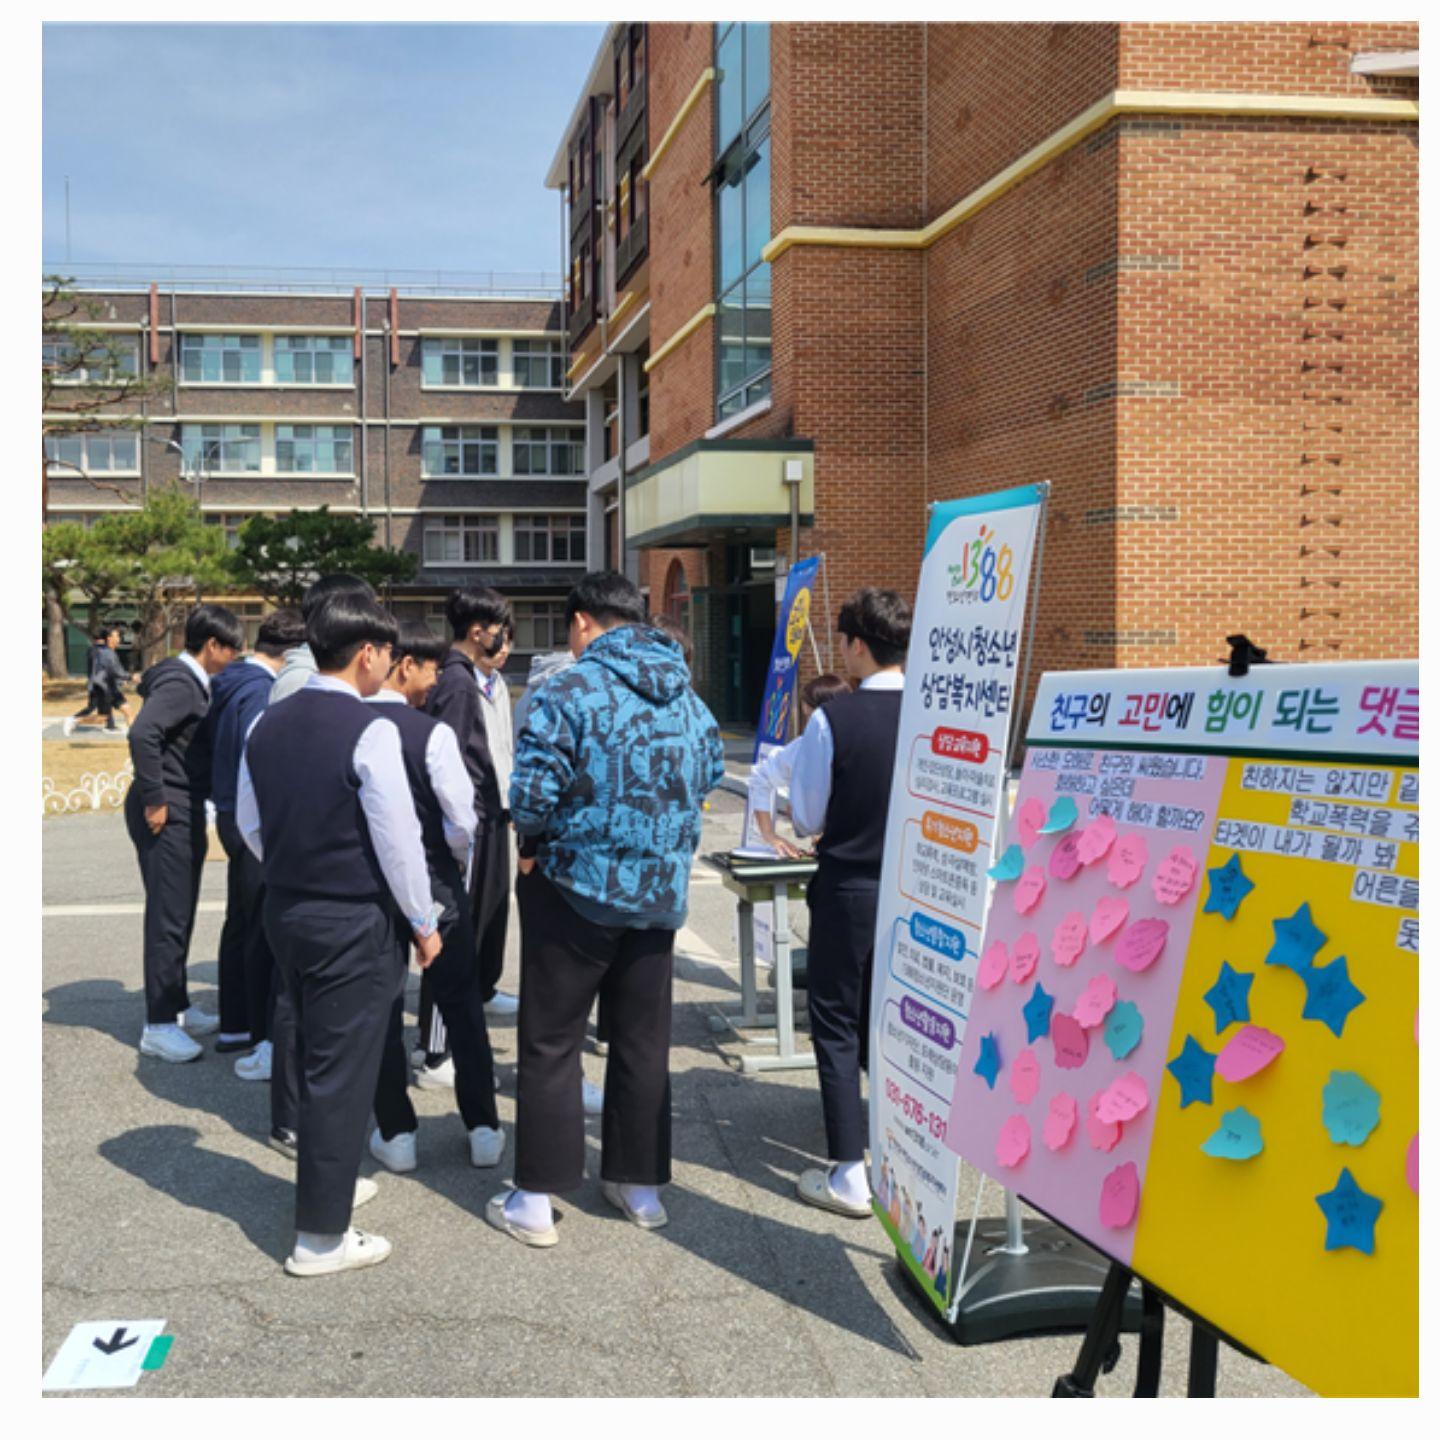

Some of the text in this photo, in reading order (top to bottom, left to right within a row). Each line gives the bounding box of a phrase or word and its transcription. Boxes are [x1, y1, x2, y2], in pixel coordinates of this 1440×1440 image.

[963, 538, 1014, 603] 1388
[929, 626, 1017, 668] 안성시청소년
[920, 672, 1010, 717] 상담복지센터
[1050, 691, 1111, 734] 친구의
[1117, 691, 1196, 733] 고민에
[1204, 688, 1264, 734] 힘이
[1272, 687, 1340, 734] 되는
[1241, 764, 1316, 793] 친하지는
[1324, 768, 1390, 799] 않지만
[1289, 796, 1393, 839] 학교폭력을
[1213, 819, 1267, 851] 타겟이
[1273, 828, 1312, 858] 내가
[1321, 833, 1363, 865] 될까
